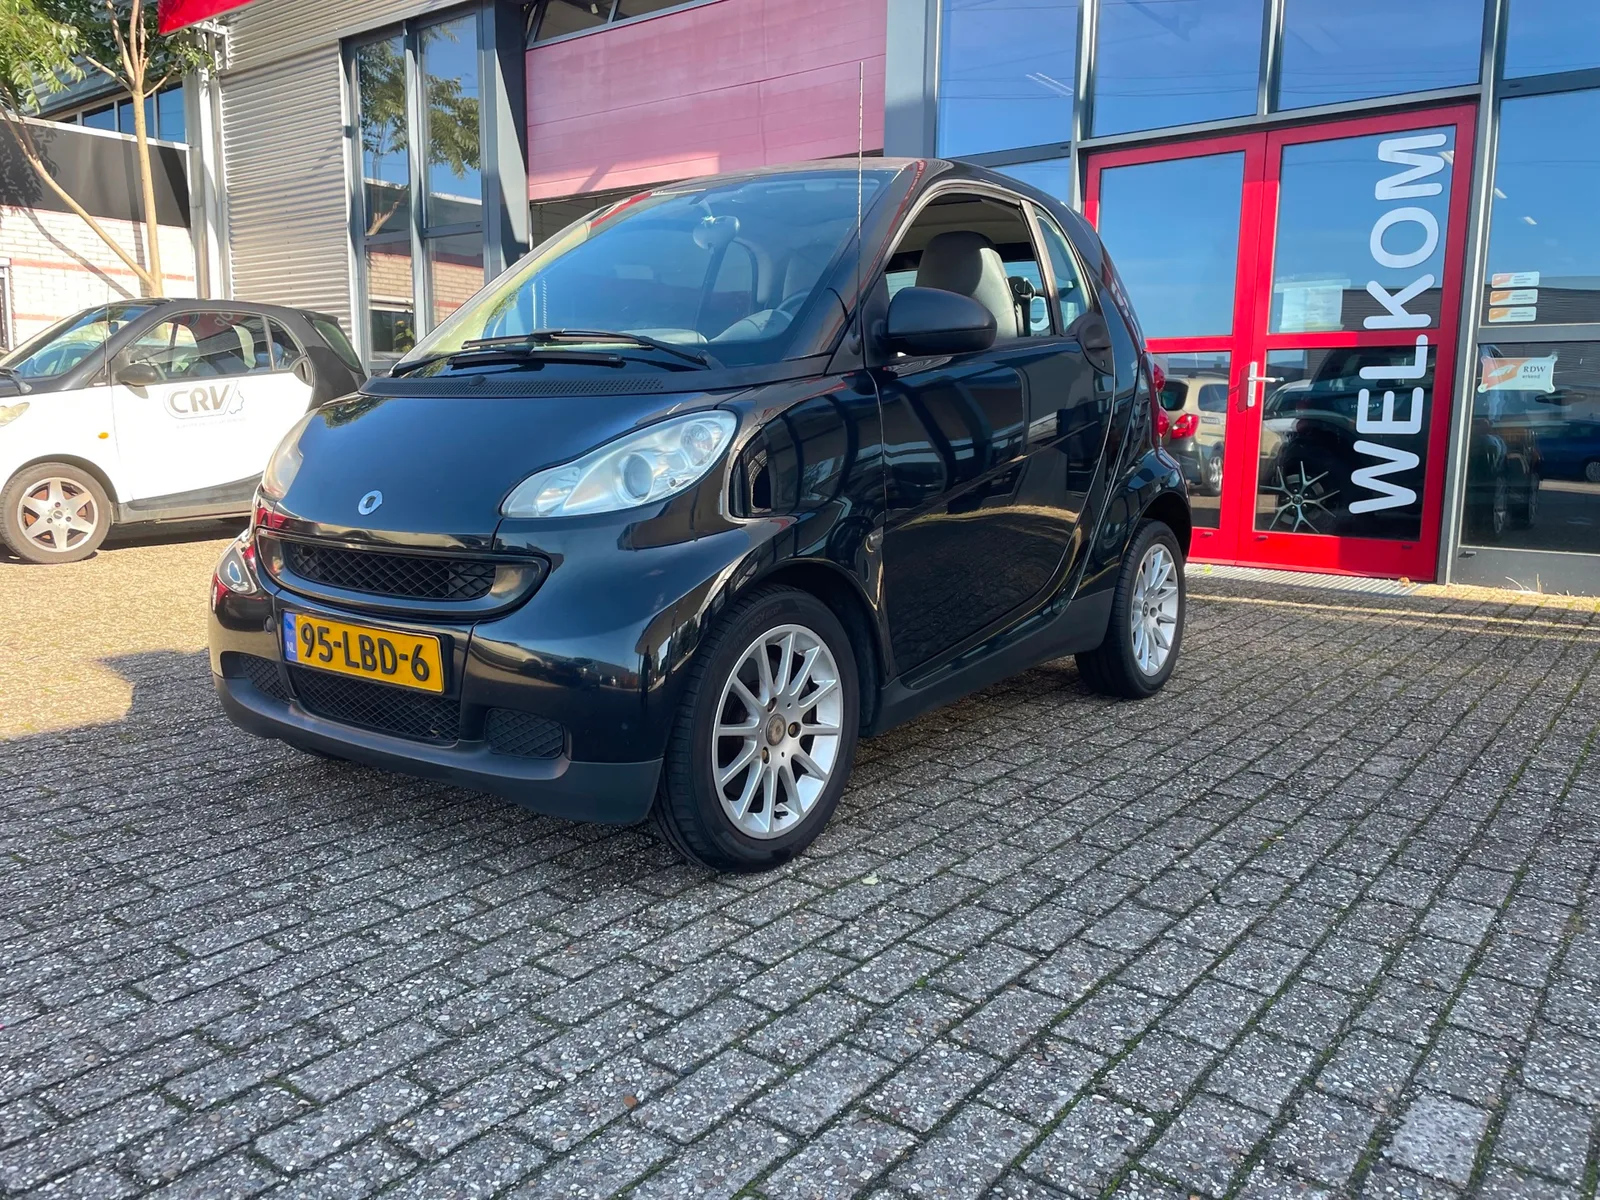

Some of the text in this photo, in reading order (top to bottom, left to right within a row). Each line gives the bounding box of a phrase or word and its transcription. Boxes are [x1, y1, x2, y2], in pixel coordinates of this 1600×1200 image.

[1348, 133, 1447, 515] WELKOM
[170, 384, 230, 413] CRV
[286, 641, 296, 653] NL
[301, 623, 430, 681] 95-LBD-6
